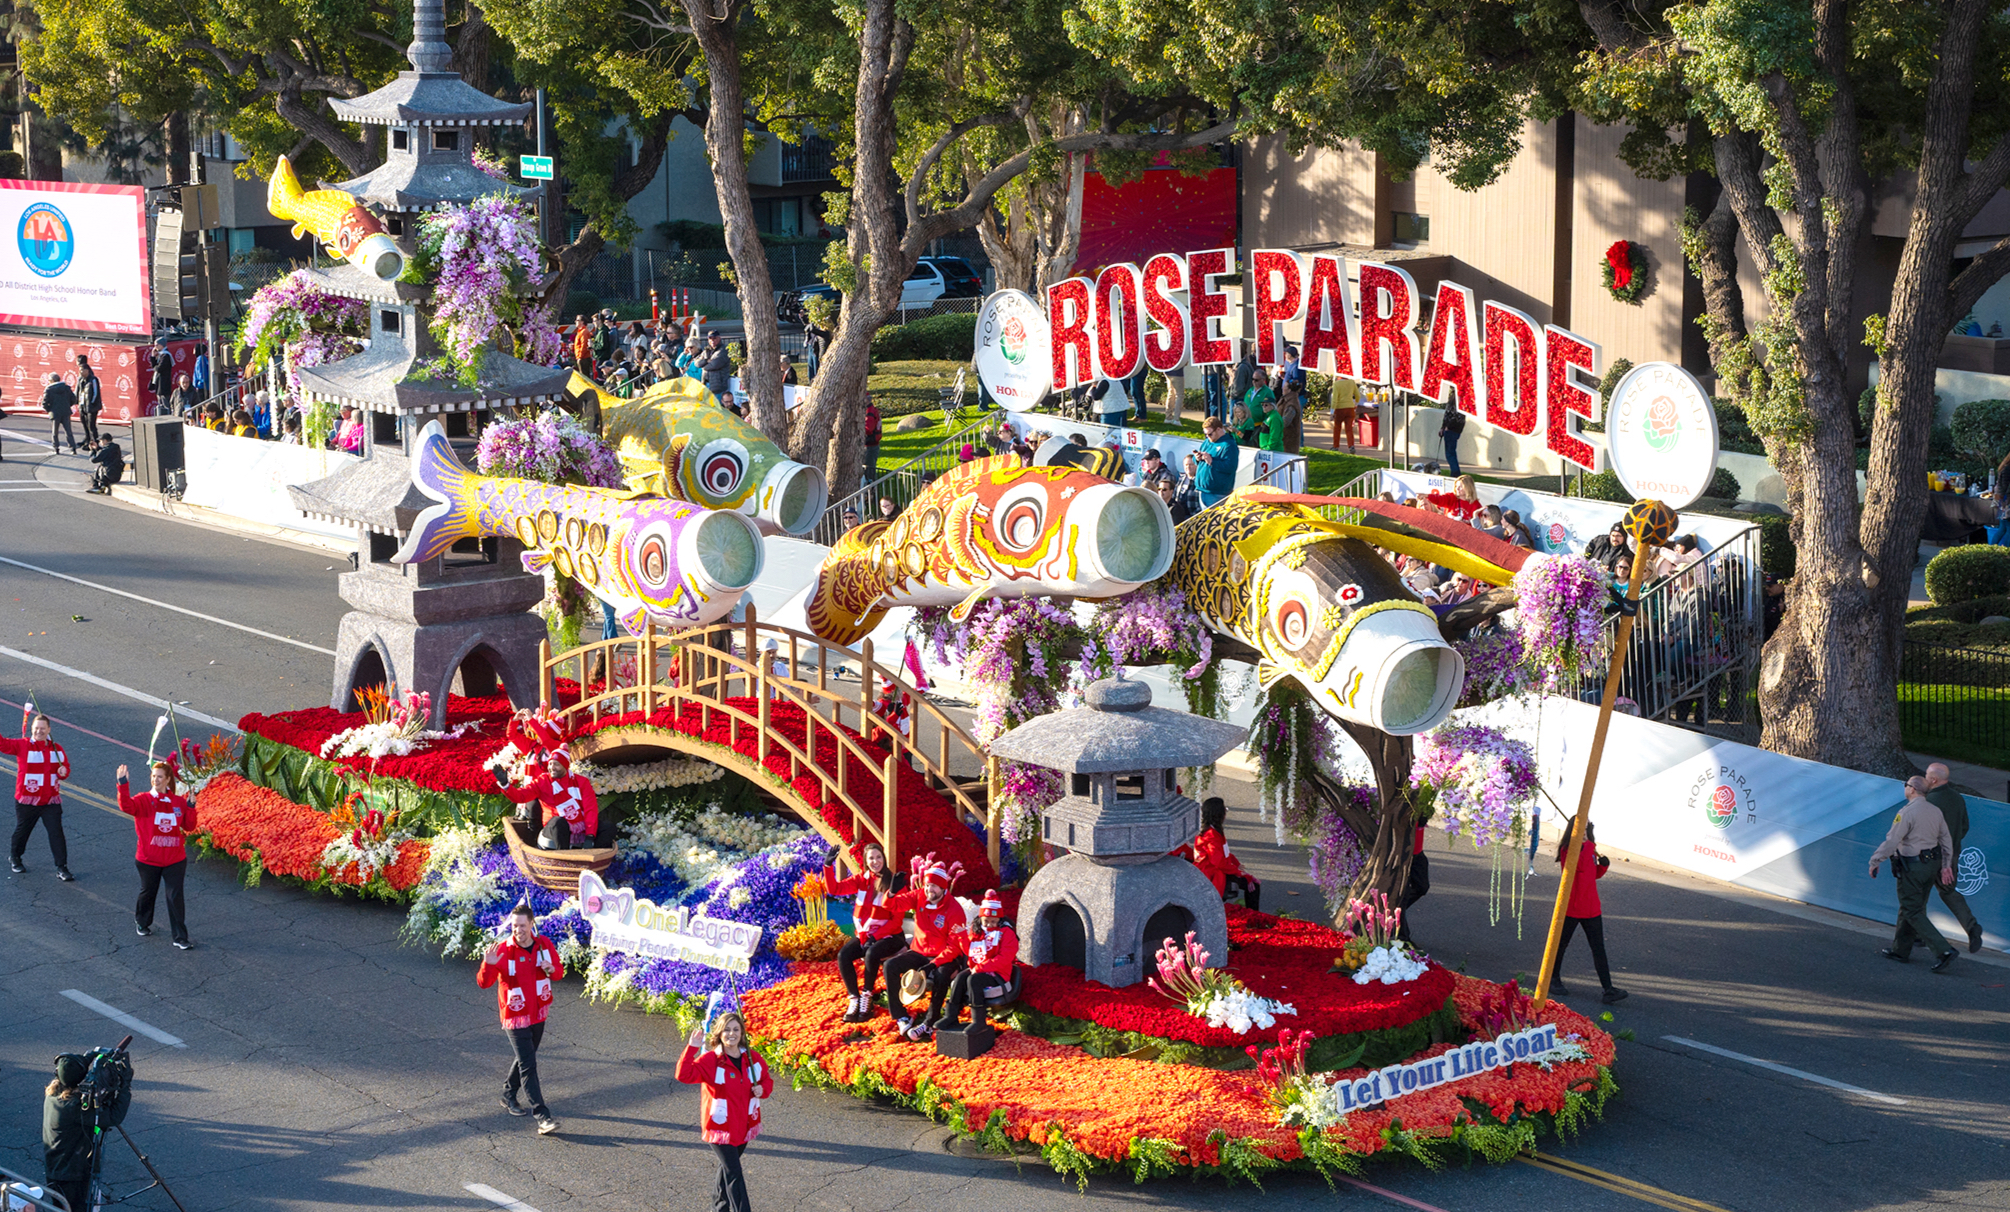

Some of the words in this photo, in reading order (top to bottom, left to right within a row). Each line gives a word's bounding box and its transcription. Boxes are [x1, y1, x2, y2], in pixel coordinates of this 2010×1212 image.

[23, 209, 31, 219] LOS
[31, 203, 50, 212] ANGELES
[49, 206, 66, 222] UNIFIED
[25, 256, 38, 271] READY
[38, 268, 47, 276] FOR
[54, 259, 69, 274] WORLD
[5, 281, 13, 289] All
[14, 281, 37, 291] District
[38, 284, 53, 293] High
[54, 284, 76, 294] School
[77, 287, 97, 295] Honor
[99, 288, 116, 297] Band
[40, 295, 60, 303] Angeles,
[104, 322, 117, 330] Best
[118, 324, 129, 332] Day
[983, 300, 1004, 347] ROSE
[1047, 247, 1241, 394] ROSE
[1251, 248, 1604, 475] PARADE
[995, 385, 1035, 400] HONDA
[1620, 376, 1648, 433] ROSE
[1653, 370, 1706, 440] PARADE
[1127, 431, 1137, 445] 15
[1258, 452, 1271, 462] AISLE
[1260, 461, 1269, 482] 3
[1428, 478, 1443, 487] AISLE
[1636, 480, 1691, 495] HONDA
[1688, 768, 1715, 809] ROSE
[1720, 765, 1757, 824] PARADE
[1693, 844, 1738, 863] HONDA
[635, 903, 760, 954] OneLegacy
[593, 931, 636, 951] Helping
[639, 937, 679, 959] People
[679, 946, 722, 966] Donate
[725, 955, 748, 972] Life
[1341, 1075, 1382, 1110] Let
[1386, 1060, 1446, 1096] Your
[1451, 1045, 1499, 1078] Life
[1501, 1027, 1556, 1063] Soar
